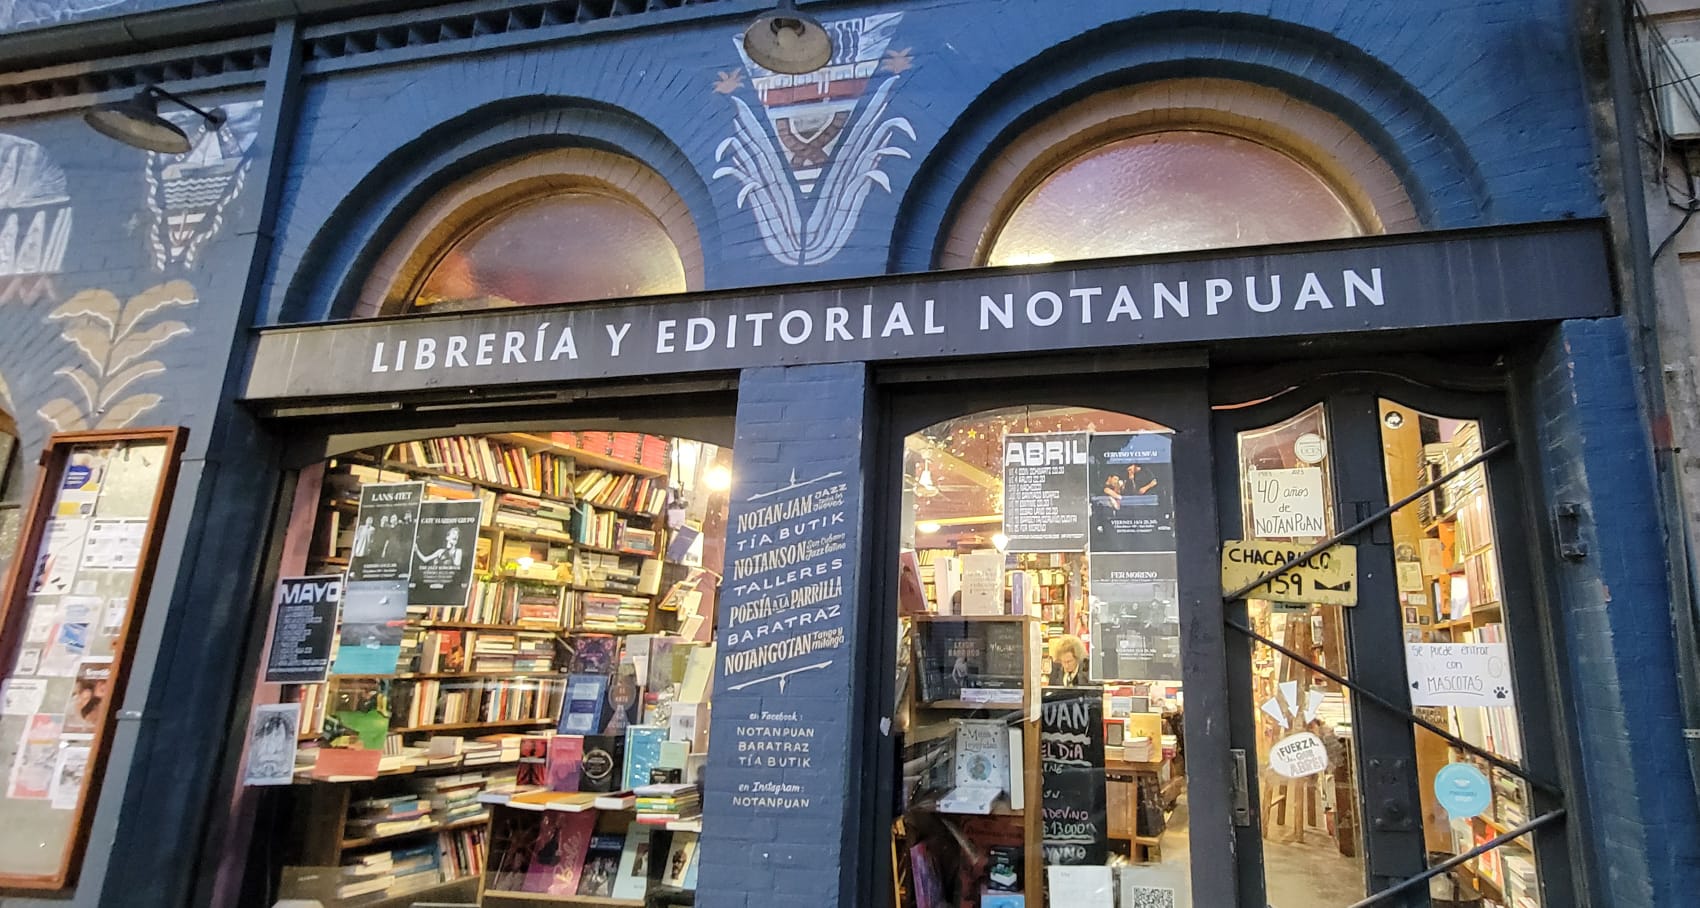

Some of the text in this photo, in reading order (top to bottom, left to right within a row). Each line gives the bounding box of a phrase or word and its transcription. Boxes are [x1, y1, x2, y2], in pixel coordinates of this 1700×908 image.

[372, 267, 1386, 373] LIBRERÍA Y EDITORIAL NOTANPUAN
[1005, 440, 1086, 467] ABRIL
[815, 483, 848, 500] JAZZ
[1257, 479, 1310, 504] 40 años
[1278, 503, 1292, 513] de
[736, 511, 845, 551] TÍA BUTIK
[805, 547, 825, 561] Jazz
[733, 558, 843, 597] TALLERES
[279, 581, 341, 605] MAYO
[728, 593, 772, 629] POESÍA
[790, 575, 843, 610] PARRILLA
[728, 604, 841, 646] BARATRAZ
[811, 634, 845, 651] milonga
[813, 628, 836, 641] Tango
[724, 632, 812, 677] NOTANGOTAN
[1446, 660, 1463, 669] con
[1427, 675, 1484, 692] MASCOTAS
[736, 726, 815, 738] NOTANPUAN
[738, 741, 810, 753] BARATRAZ
[738, 754, 812, 768] TÍA BUTIK
[738, 784, 750, 792] en
[732, 796, 810, 809] NOTANPUAN
